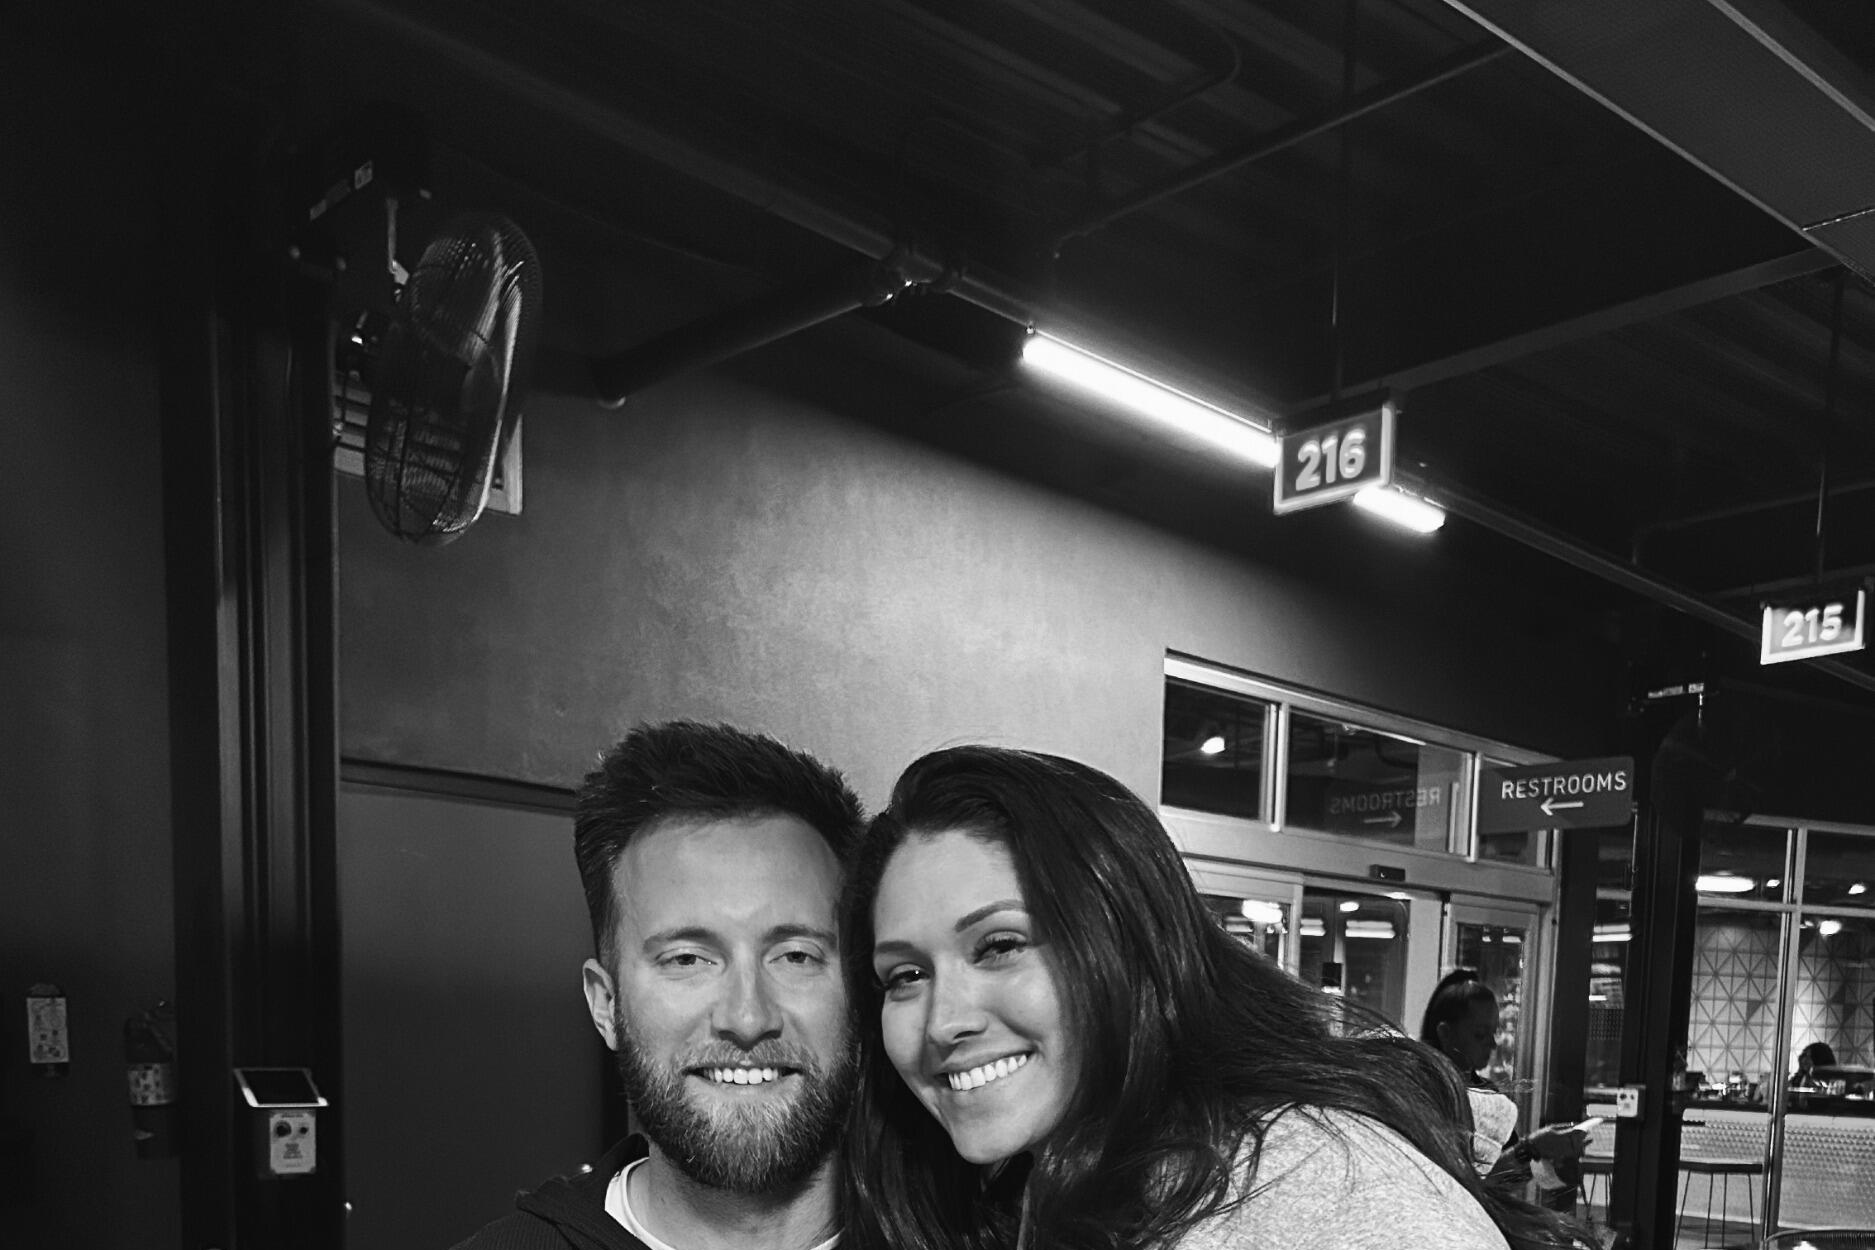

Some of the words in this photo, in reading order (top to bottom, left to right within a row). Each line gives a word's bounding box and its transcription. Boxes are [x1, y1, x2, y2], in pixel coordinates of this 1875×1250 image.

[1295, 427, 1366, 491] 216
[1781, 604, 1843, 647] 215
[1501, 770, 1627, 799] RESTROOMS
